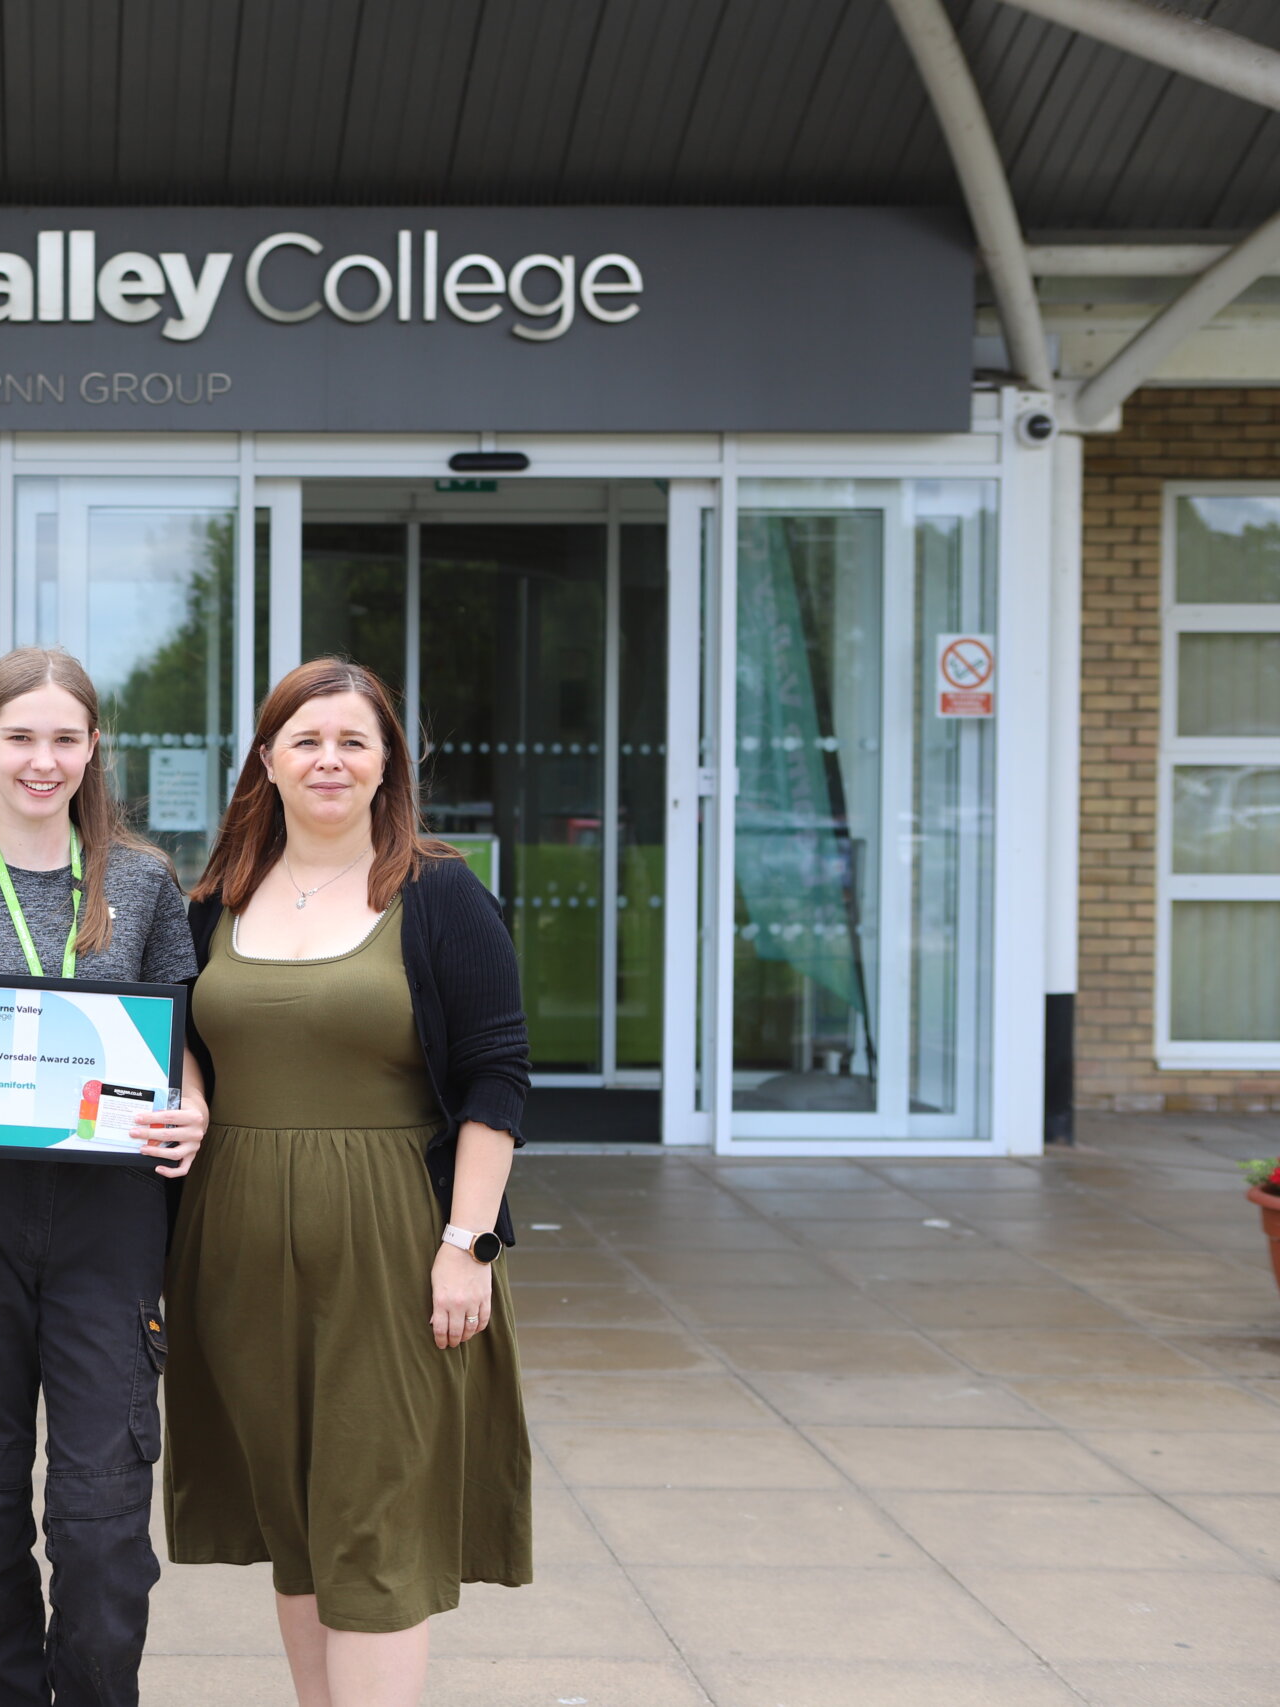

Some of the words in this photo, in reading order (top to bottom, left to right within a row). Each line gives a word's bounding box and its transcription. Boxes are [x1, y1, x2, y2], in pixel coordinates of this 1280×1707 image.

[245, 229, 644, 341] College
[79, 371, 232, 405] GROUP
[16, 1005, 43, 1016] Valley
[39, 1055, 70, 1064] Award
[72, 1056, 96, 1066] 2026
